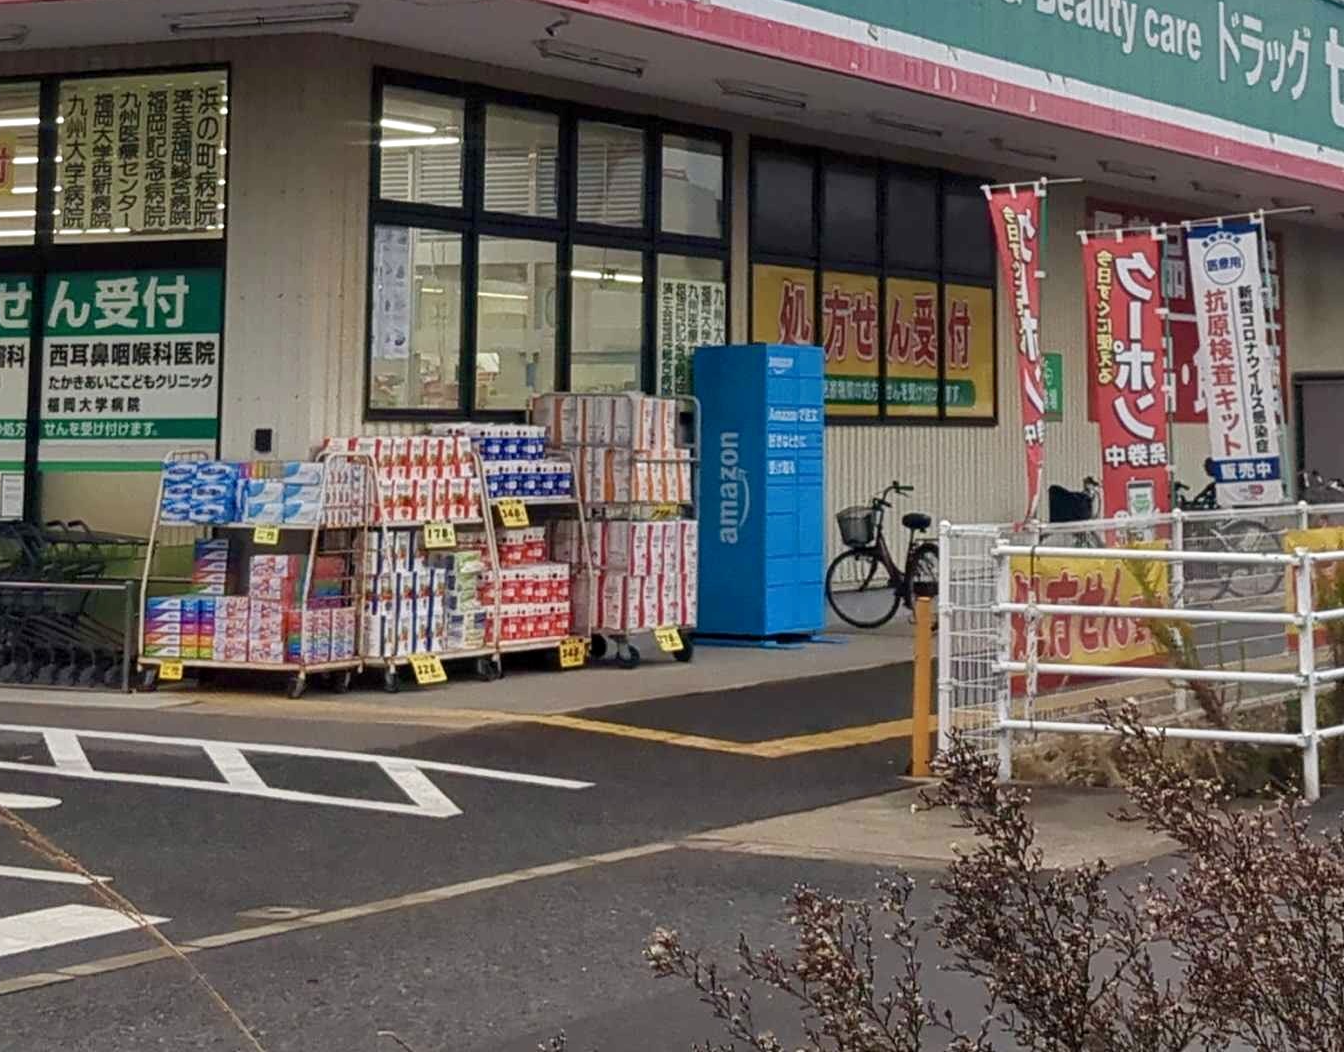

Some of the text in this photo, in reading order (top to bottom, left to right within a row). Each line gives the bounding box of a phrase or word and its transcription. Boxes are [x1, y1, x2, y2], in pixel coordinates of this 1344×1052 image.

[1144, 10, 1202, 60] care
[1218, 0, 1310, 101] ドラッグ
[62, 93, 88, 228] 九州大学病院
[118, 91, 142, 227] 九州医療センター
[144, 90, 168, 228] 福岡記念病院
[194, 86, 220, 227] 浜の町病院
[1206, 254, 1242, 273] 医療用
[49, 340, 216, 367] 西耳鼻咽喉科医院
[777, 280, 972, 369] 処方せん受付
[1203, 289, 1241, 457] 抗原検査キット
[47, 397, 141, 413] 福岡大学病院
[720, 431, 739, 545] amazon
